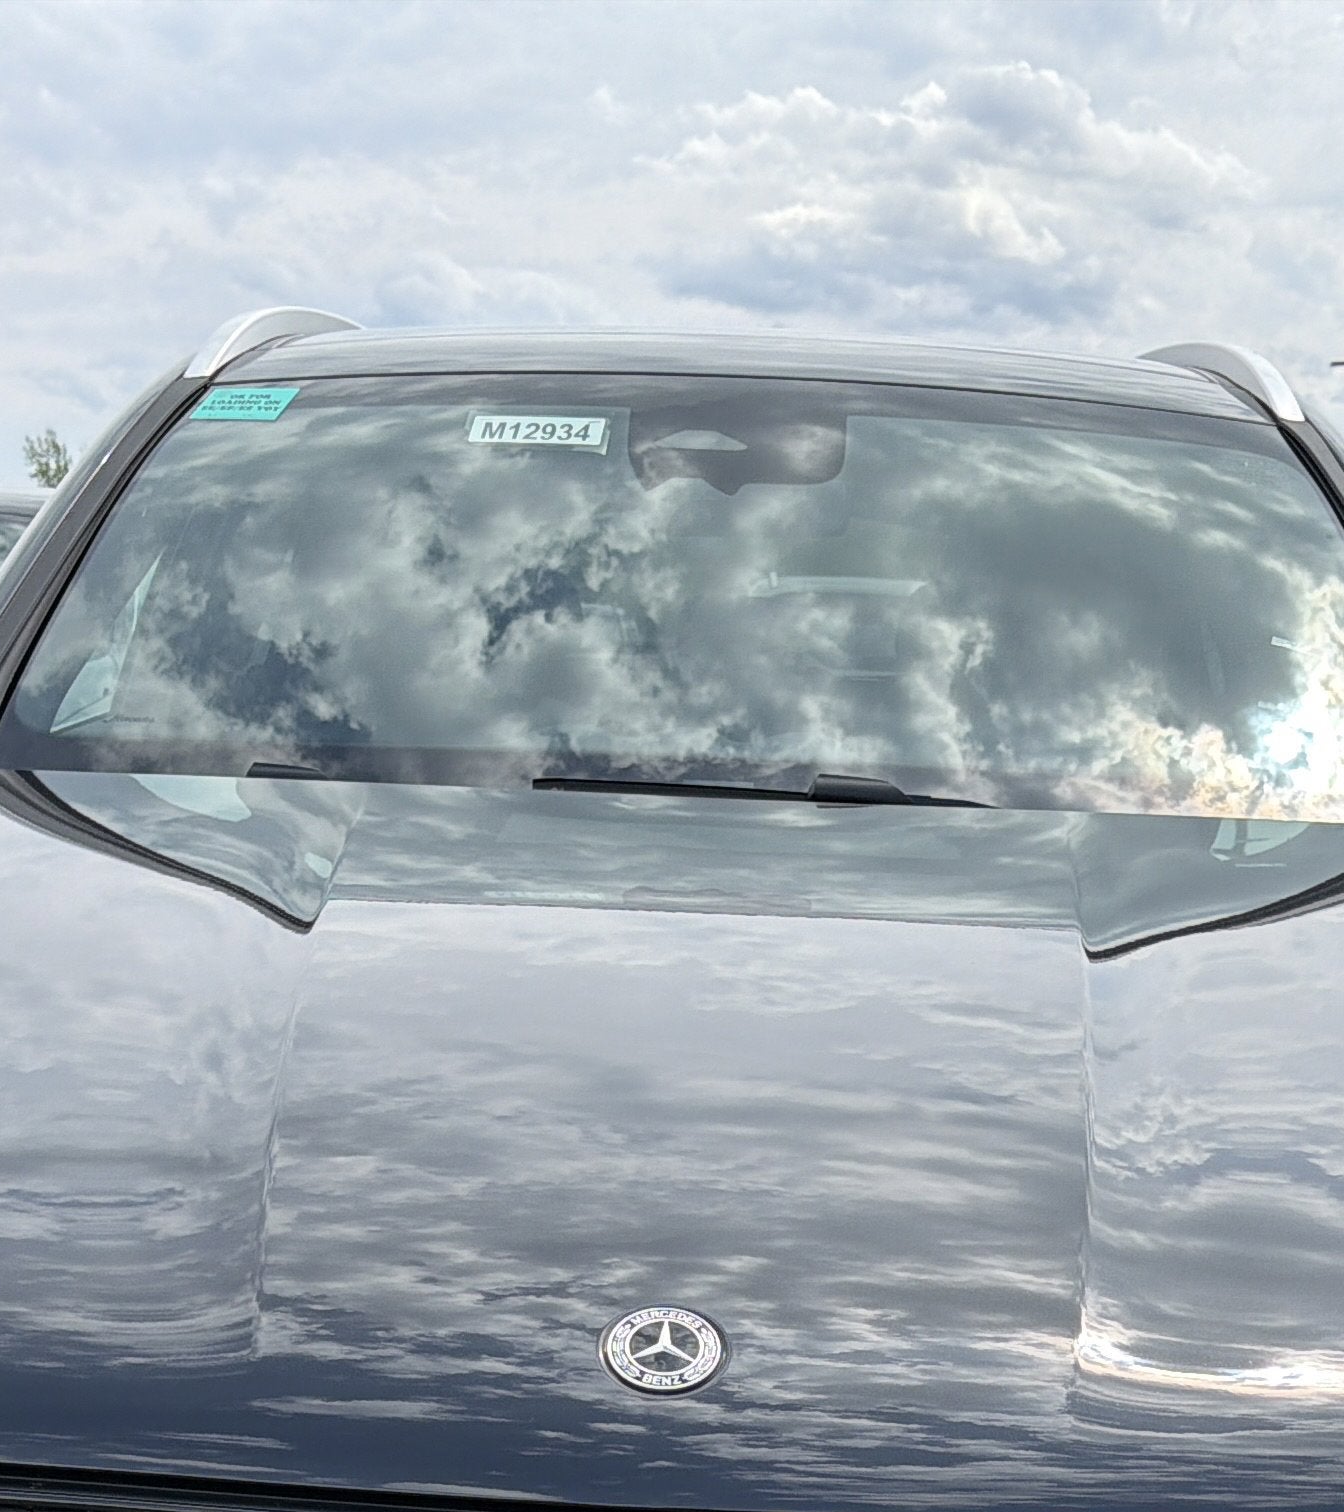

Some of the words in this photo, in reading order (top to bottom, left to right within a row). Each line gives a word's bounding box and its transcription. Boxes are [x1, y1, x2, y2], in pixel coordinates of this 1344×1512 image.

[480, 421, 591, 442] M12934
[630, 1310, 703, 1330] MERCEDES
[641, 1374, 683, 1386] BENZ
